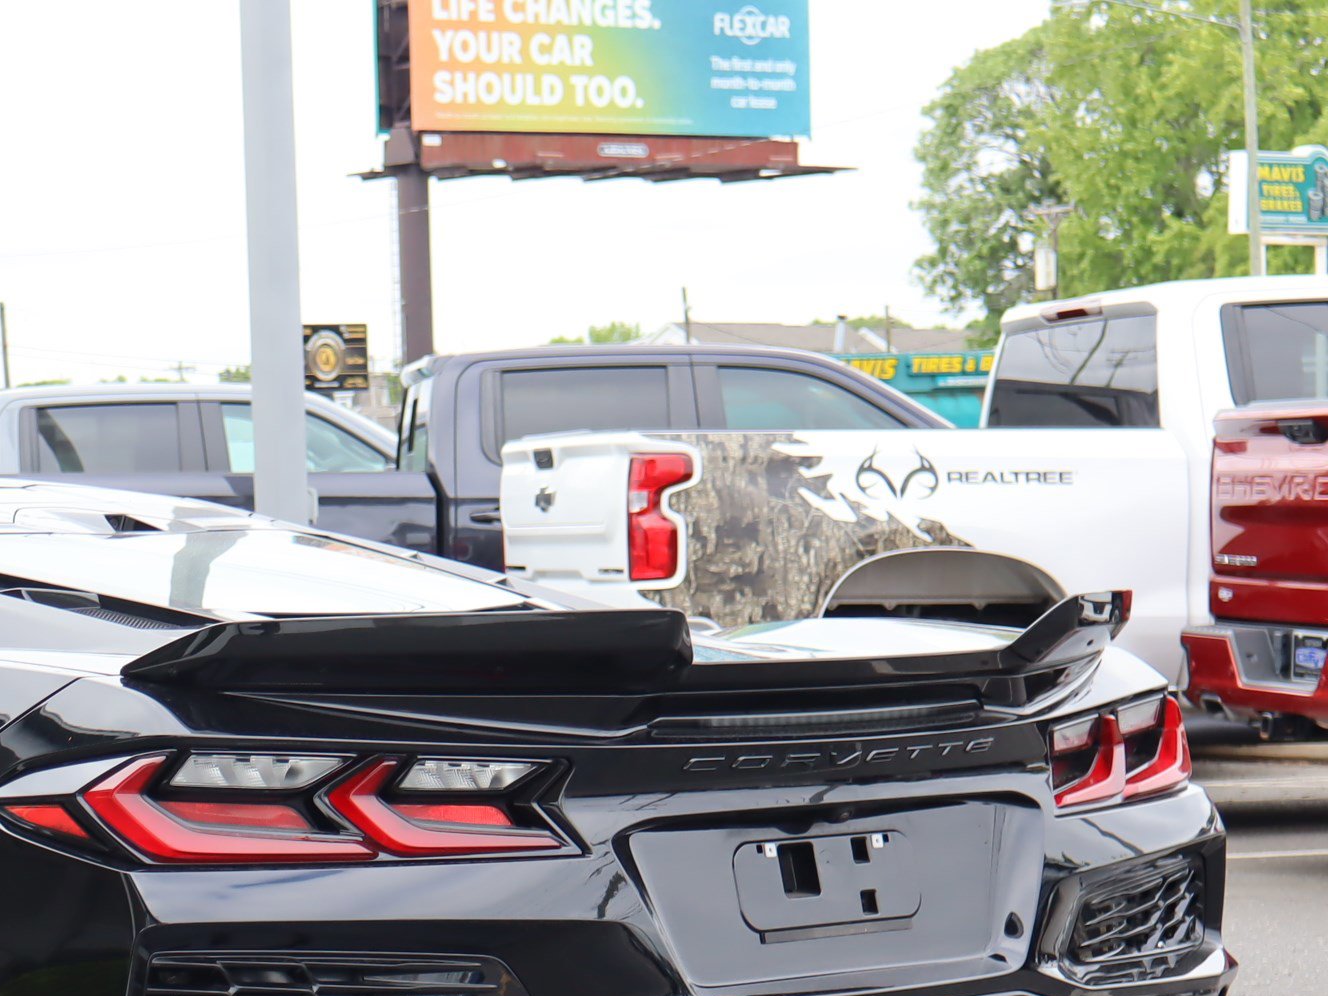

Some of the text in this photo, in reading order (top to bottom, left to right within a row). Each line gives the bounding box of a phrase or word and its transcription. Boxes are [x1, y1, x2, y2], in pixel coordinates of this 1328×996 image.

[432, 0, 661, 30] LIFE CHANGES.
[713, 11, 791, 39] FLEXCAR
[432, 29, 594, 67] YOUR CAR
[432, 70, 645, 109] SHOULD TOO.
[1258, 165, 1305, 182] MAVIS
[912, 355, 964, 374] TIRES
[946, 471, 1074, 485] REALTREE
[683, 737, 994, 771] CORVETTE
